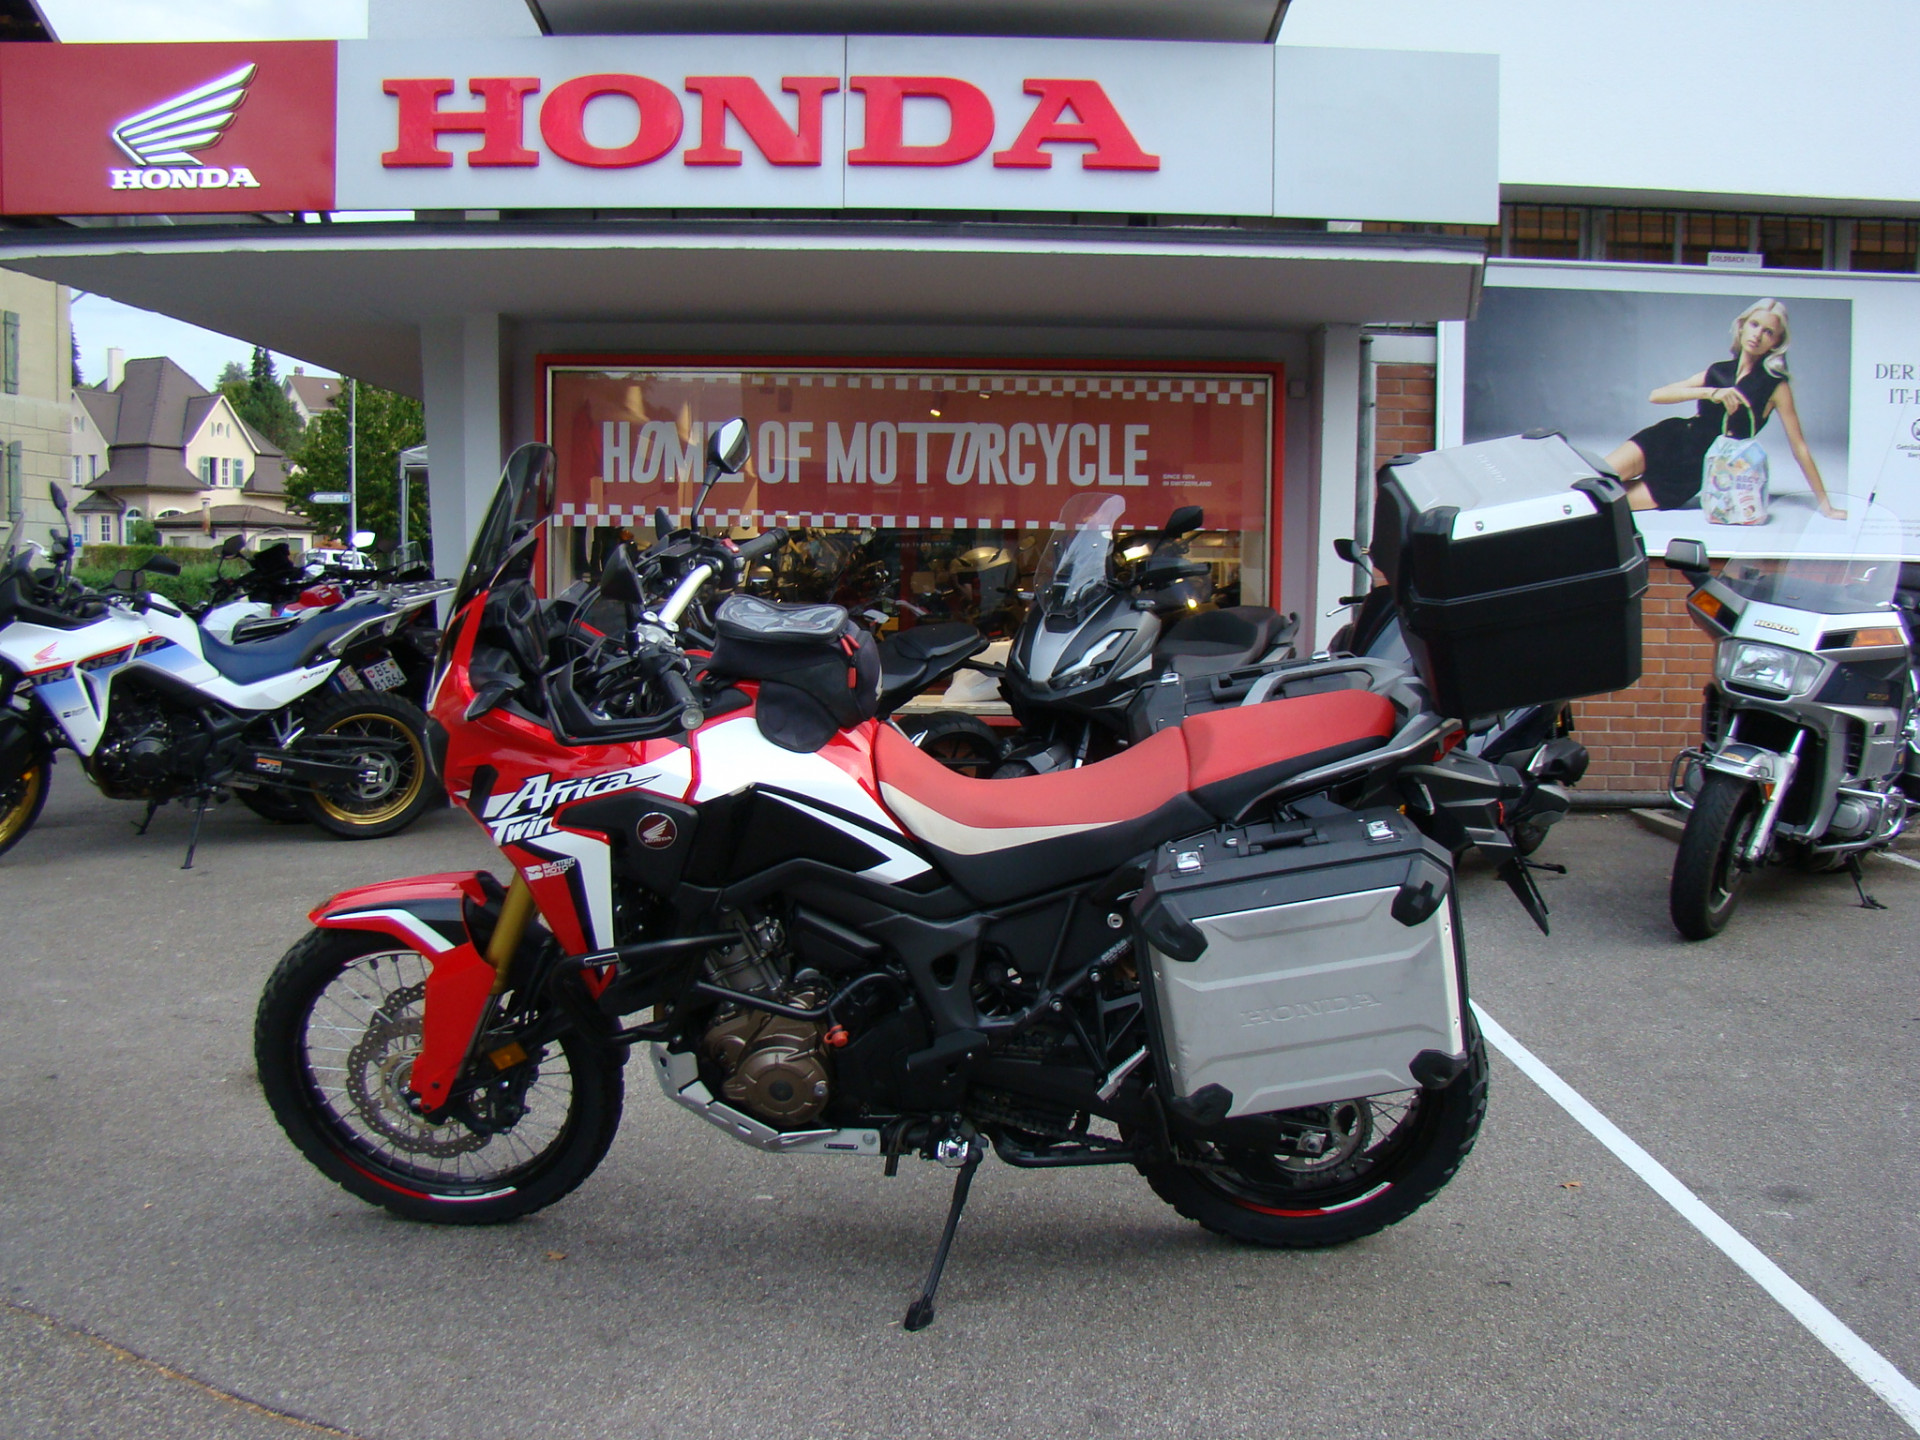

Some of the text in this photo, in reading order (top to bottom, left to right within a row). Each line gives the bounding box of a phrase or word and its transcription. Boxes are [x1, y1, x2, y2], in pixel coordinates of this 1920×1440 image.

[382, 73, 1160, 170] HONDA
[110, 168, 260, 190] HONDA
[1875, 363, 1914, 380] DER
[758, 420, 813, 484] OF
[826, 421, 1149, 487] MOTORCYCLE
[1754, 619, 1799, 636] HONDA
[375, 662, 391, 677] BE
[500, 772, 662, 819] Africa
[1240, 992, 1382, 1028] HONDA
